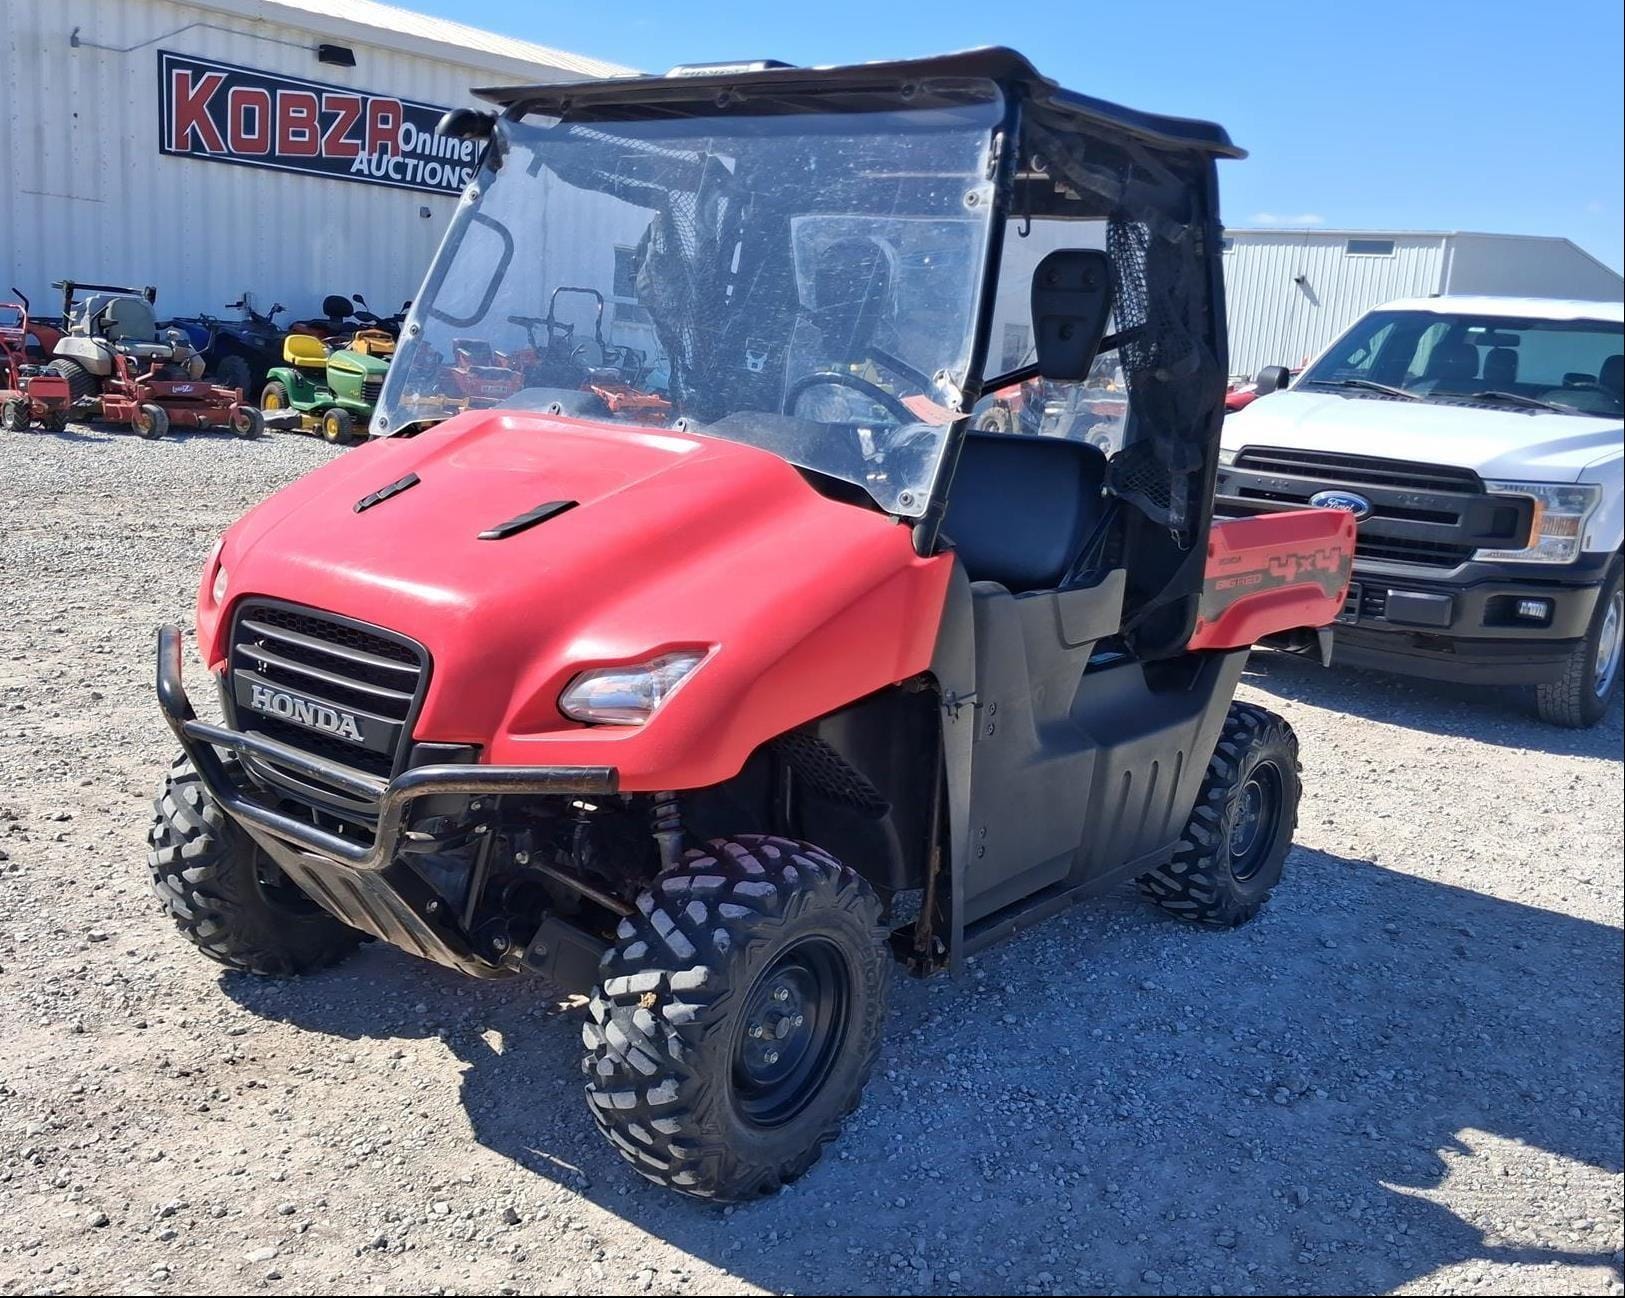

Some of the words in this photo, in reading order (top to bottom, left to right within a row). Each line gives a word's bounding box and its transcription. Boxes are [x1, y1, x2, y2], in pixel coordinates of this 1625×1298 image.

[171, 68, 403, 159] KOBZA
[398, 122, 473, 162] Online
[349, 151, 473, 190] AUCTIONS
[1269, 546, 1342, 582] 4x4
[250, 684, 366, 743] HONDA
